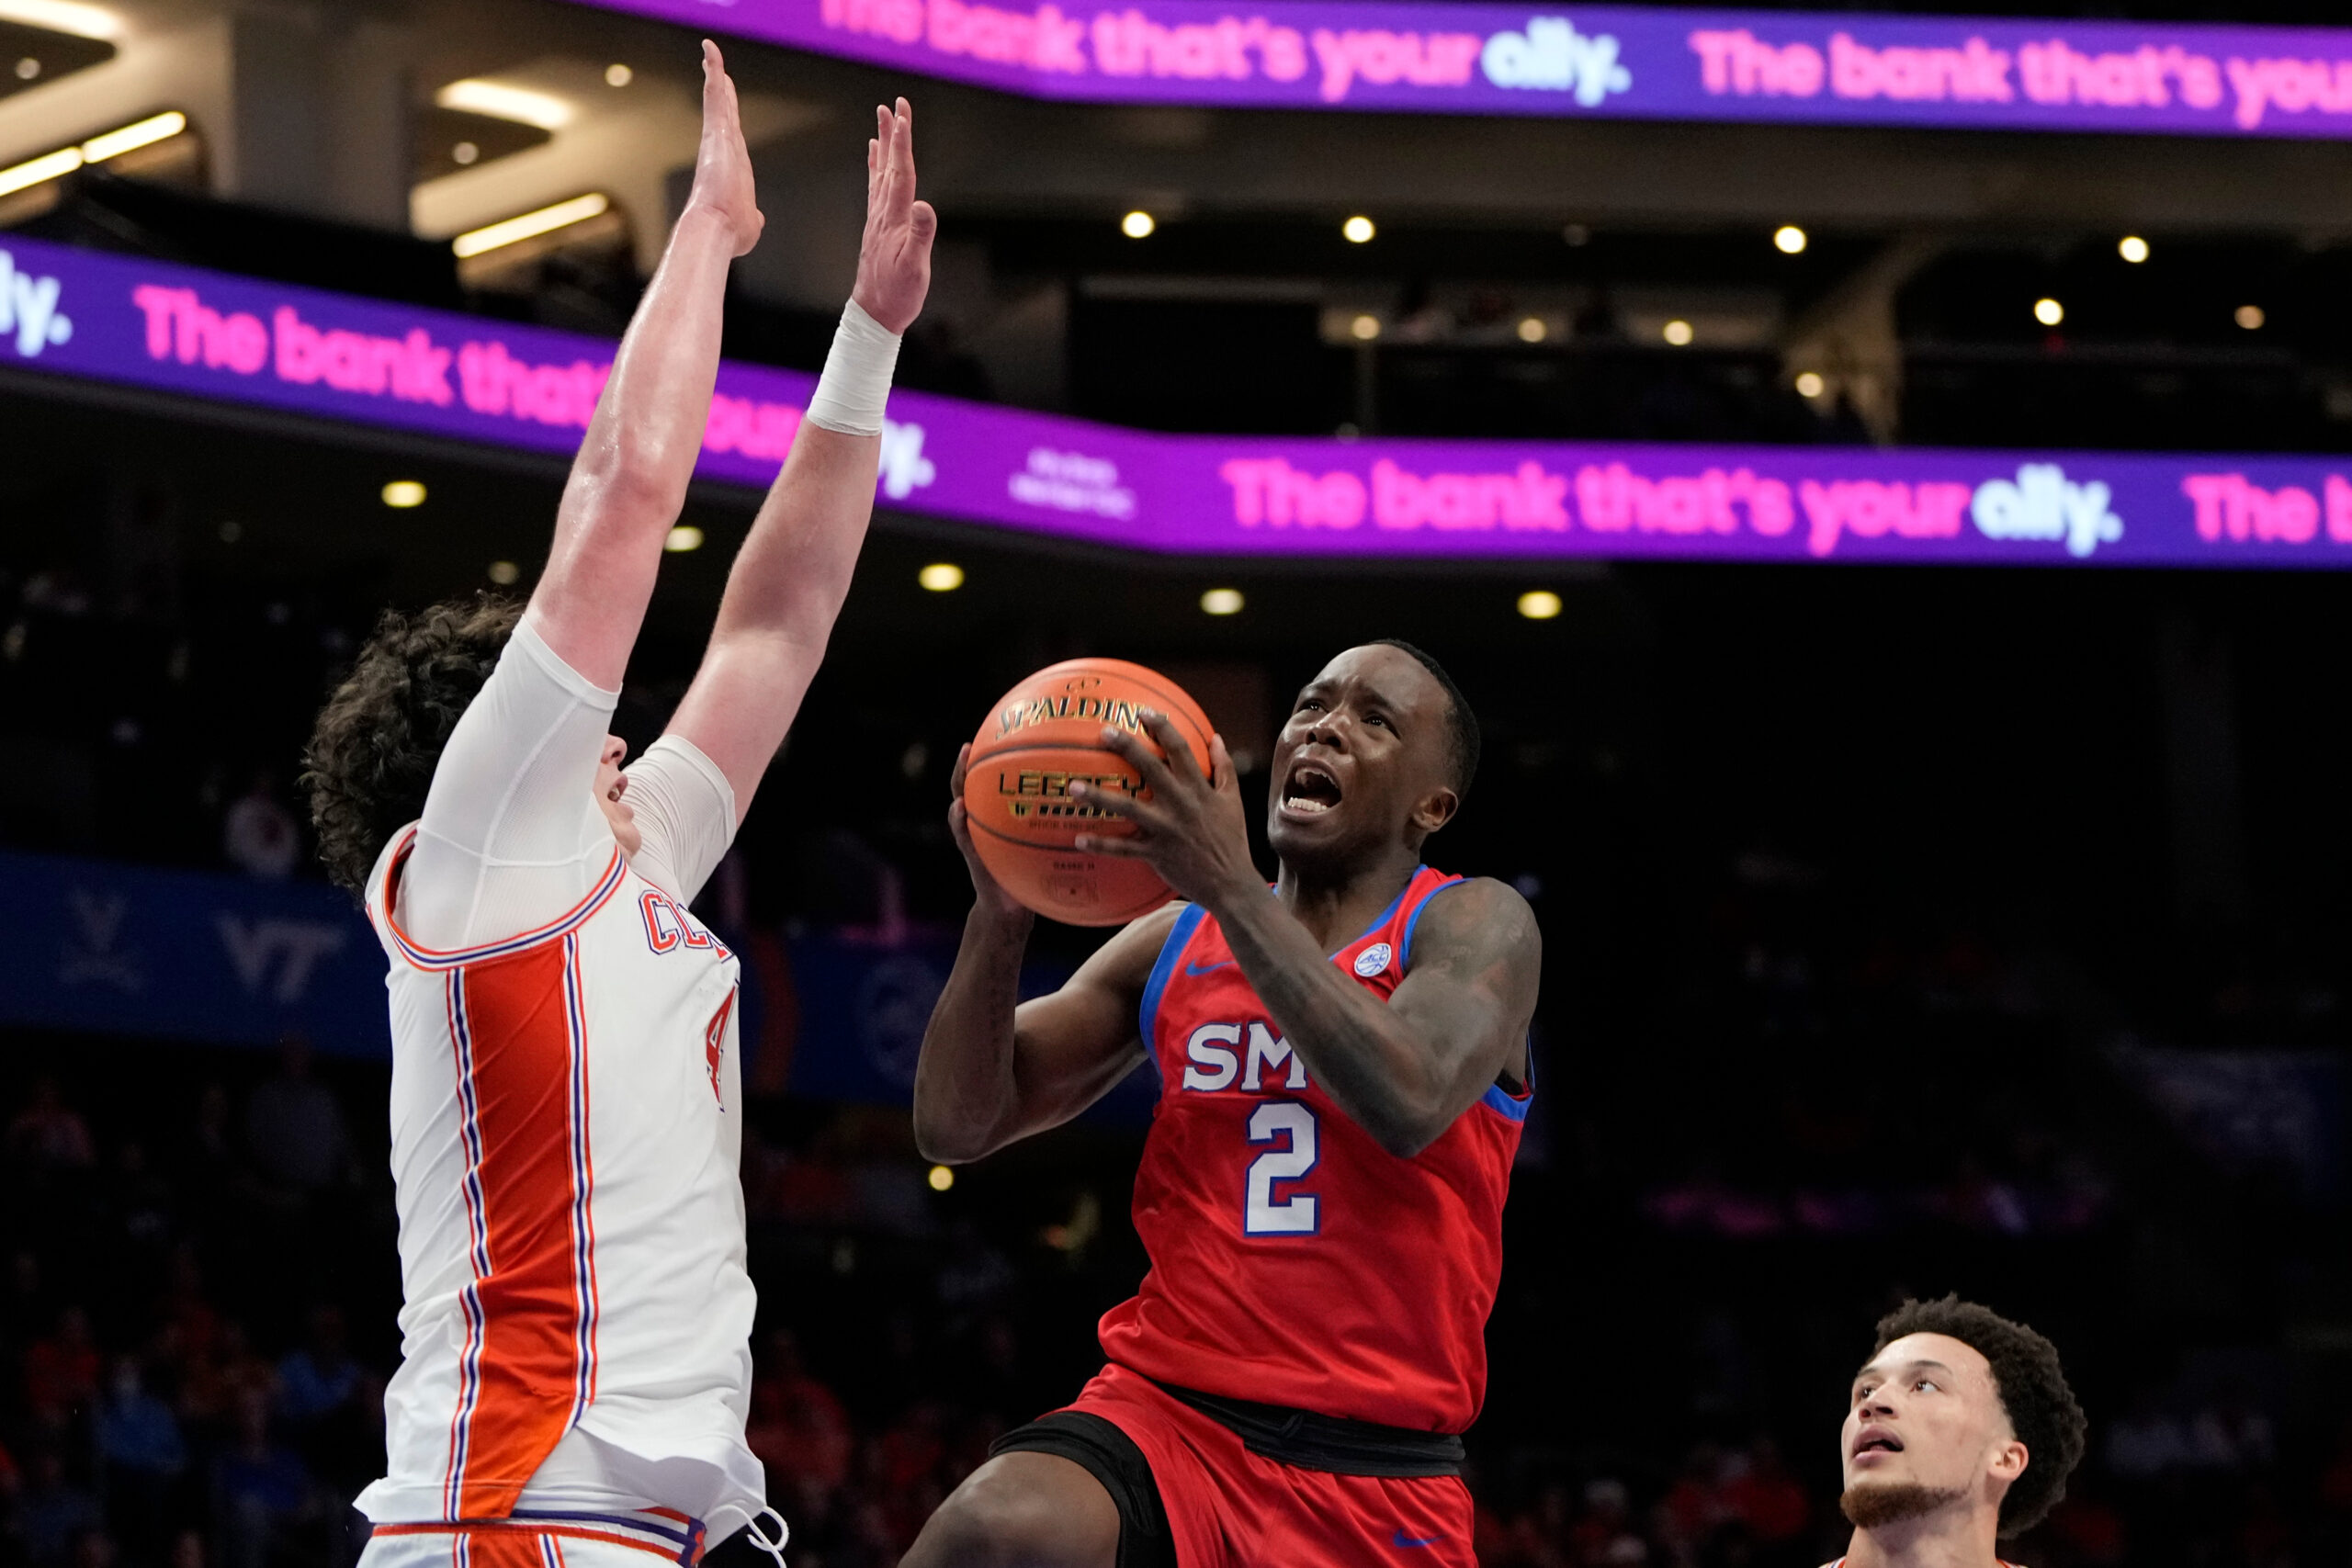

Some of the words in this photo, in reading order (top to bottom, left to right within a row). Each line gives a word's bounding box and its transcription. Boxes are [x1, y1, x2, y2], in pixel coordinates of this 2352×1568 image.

[924, 0, 1085, 74] bank
[1092, 7, 1307, 82] that's
[1310, 28, 1477, 102] your
[1481, 17, 1632, 107] ally.
[1690, 30, 1826, 96] The
[1831, 34, 2012, 101] bank
[2018, 39, 2222, 108] that's
[134, 285, 268, 374] The
[275, 307, 453, 406] bank
[1220, 457, 1367, 530] The
[1374, 457, 1569, 532] bank
[1575, 461, 1795, 536] that's
[1799, 479, 1971, 557] your
[1972, 464, 2124, 557] ally.
[2182, 473, 2320, 543] The
[212, 908, 348, 1005] VT
[1182, 1021, 1308, 1092] SM
[1244, 1099, 1320, 1236] 2
